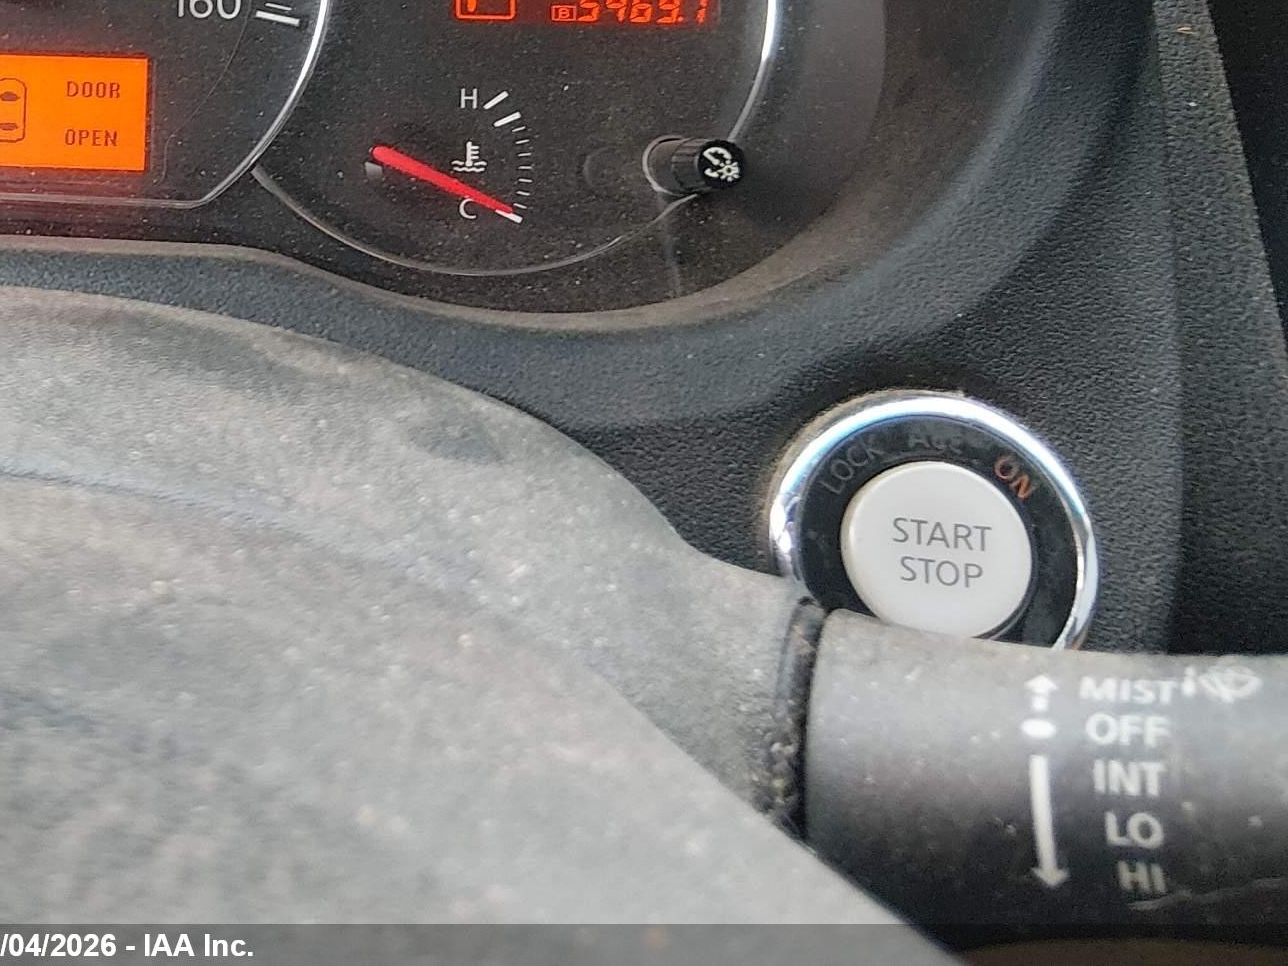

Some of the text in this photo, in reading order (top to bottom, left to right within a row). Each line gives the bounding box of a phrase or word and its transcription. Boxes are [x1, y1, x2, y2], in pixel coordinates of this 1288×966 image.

[66, 81, 121, 99] DOOR
[460, 89, 478, 109] H
[64, 129, 118, 147] OPEN
[459, 199, 477, 220] C
[821, 433, 888, 495] LOCK
[994, 454, 1036, 499] ON
[892, 517, 992, 552] START
[899, 557, 984, 588] STOP
[1079, 676, 1177, 705] MIST
[1085, 714, 1171, 747] OFF
[1093, 761, 1165, 797] INT
[1105, 811, 1165, 849] LO
[1118, 861, 1166, 894] HI
